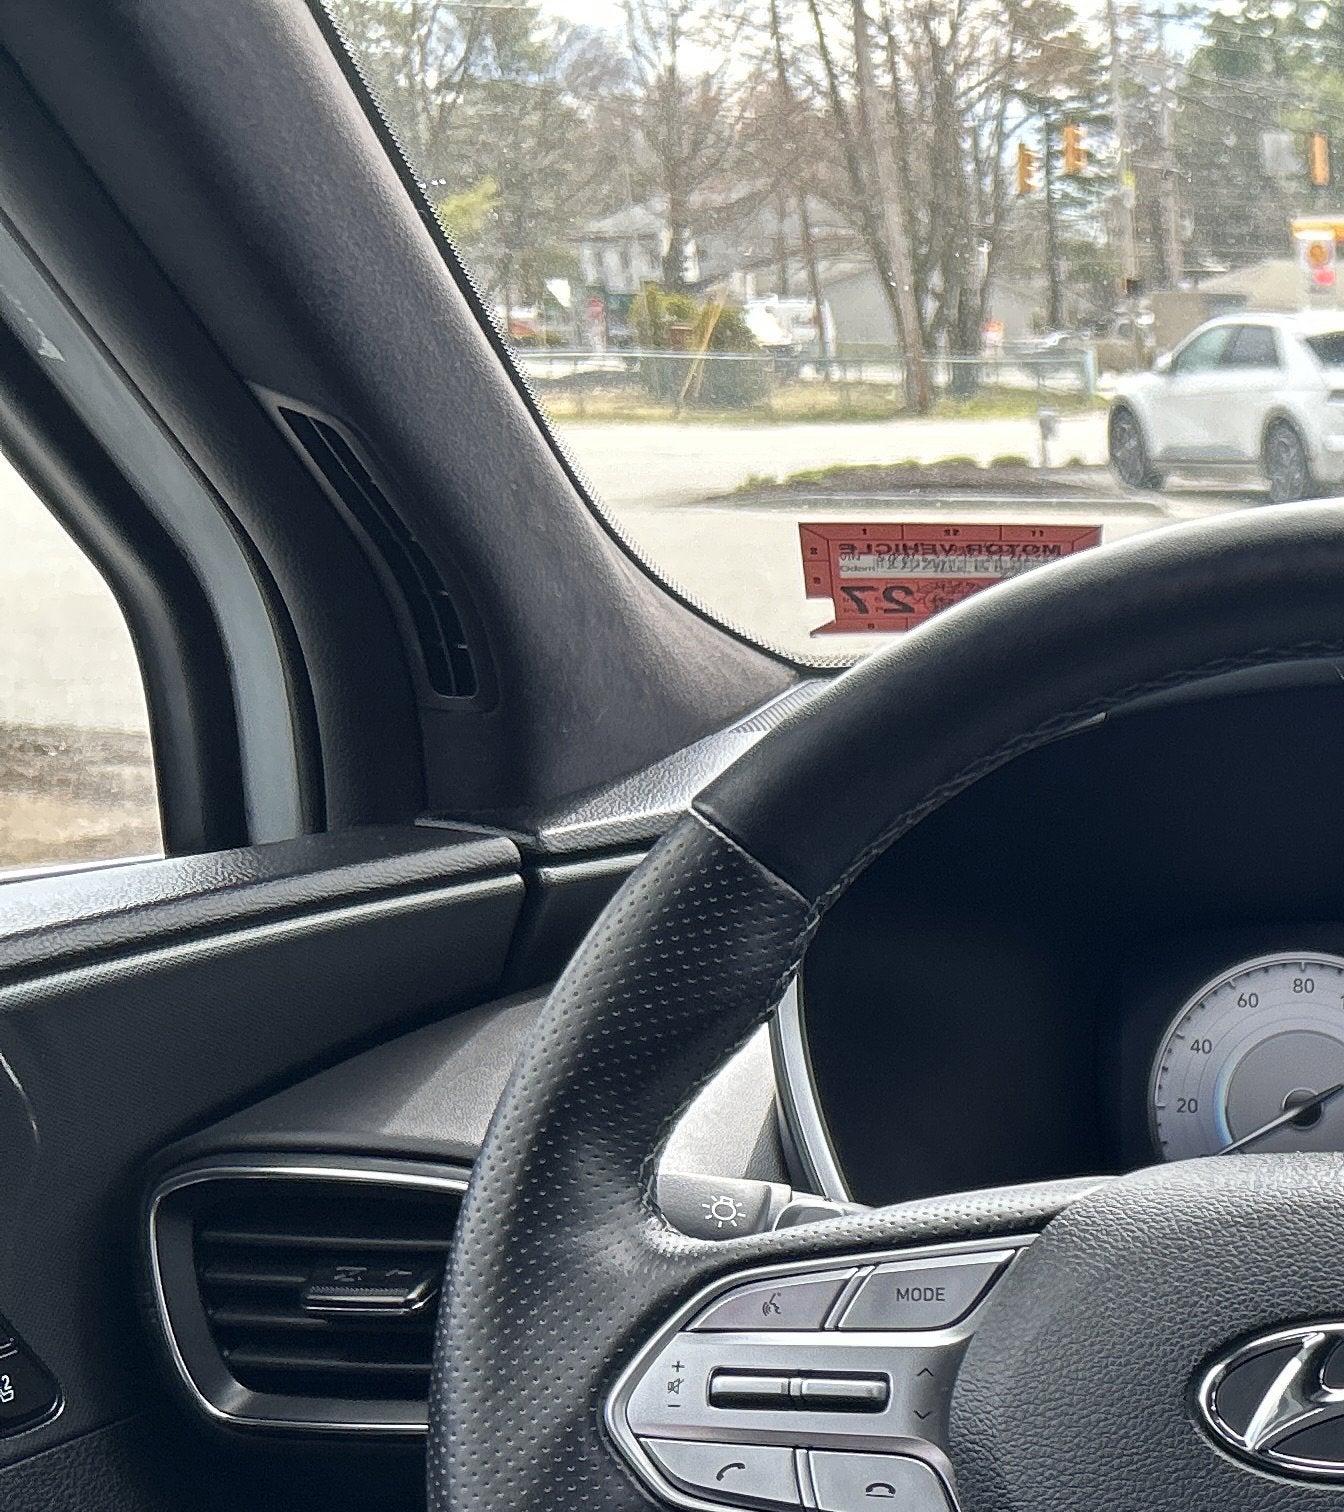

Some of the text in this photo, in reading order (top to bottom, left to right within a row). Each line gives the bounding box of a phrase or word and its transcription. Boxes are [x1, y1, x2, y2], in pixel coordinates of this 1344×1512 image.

[1293, 978, 1315, 994] 80
[1237, 992, 1259, 1009] 60
[1190, 1039, 1213, 1055] 40
[1176, 1098, 1198, 1114] 20
[896, 1286, 946, 1303] MODE
